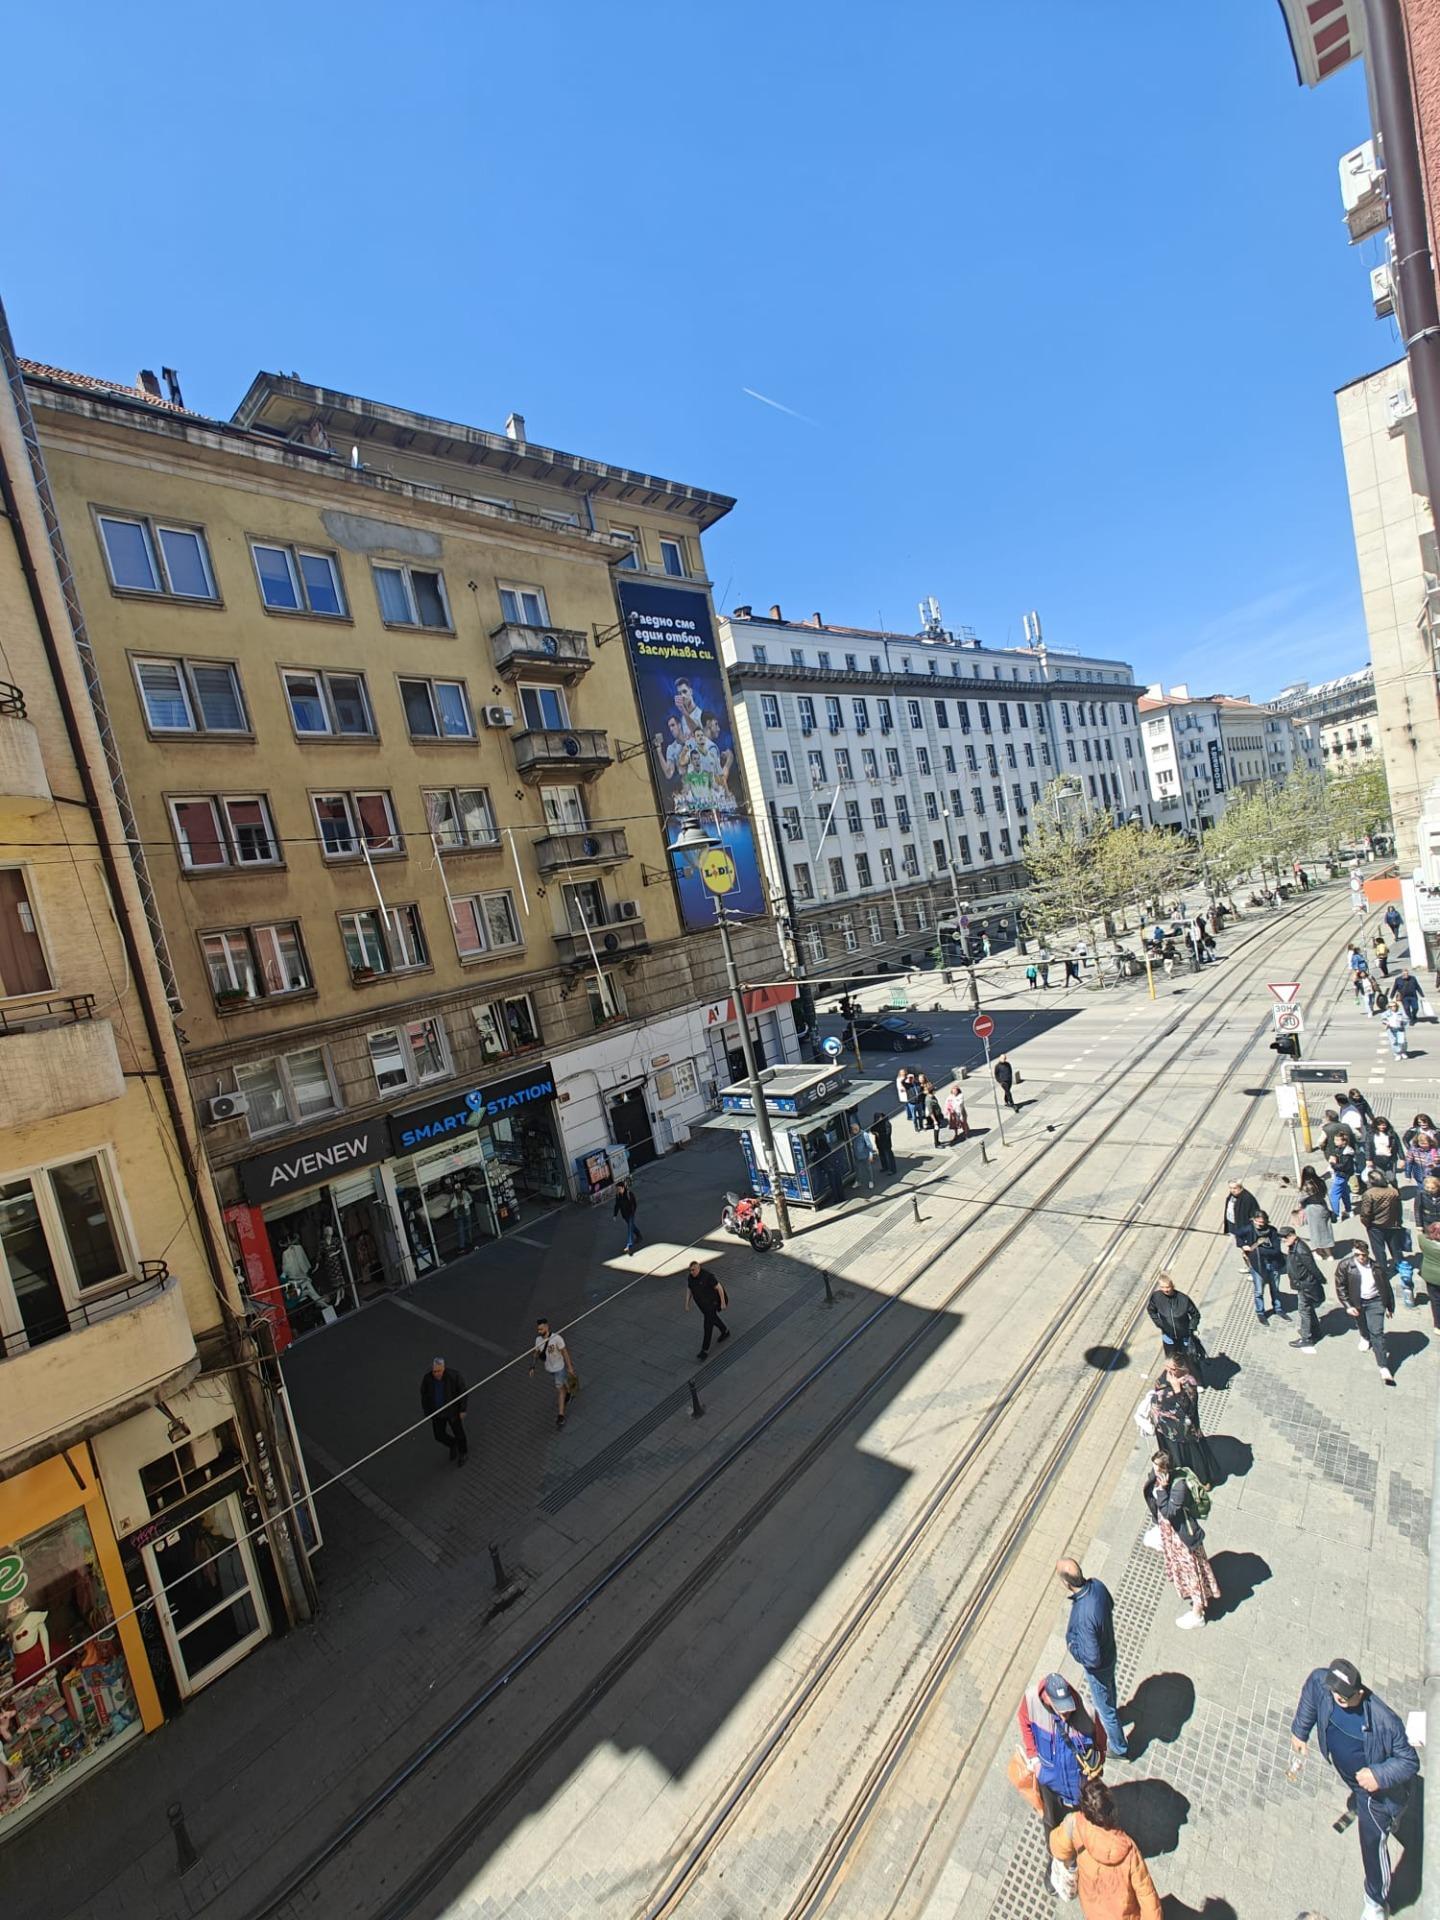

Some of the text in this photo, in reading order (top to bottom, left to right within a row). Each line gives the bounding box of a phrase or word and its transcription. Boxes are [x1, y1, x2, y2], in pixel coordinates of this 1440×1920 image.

[675, 619, 696, 630] сме
[635, 629, 705, 647] един отбор.
[638, 642, 715, 660] Заслужава си.
[708, 1005, 719, 1025] A1
[402, 1081, 552, 1147] SMART STATION
[270, 1135, 368, 1187] AVENEW
